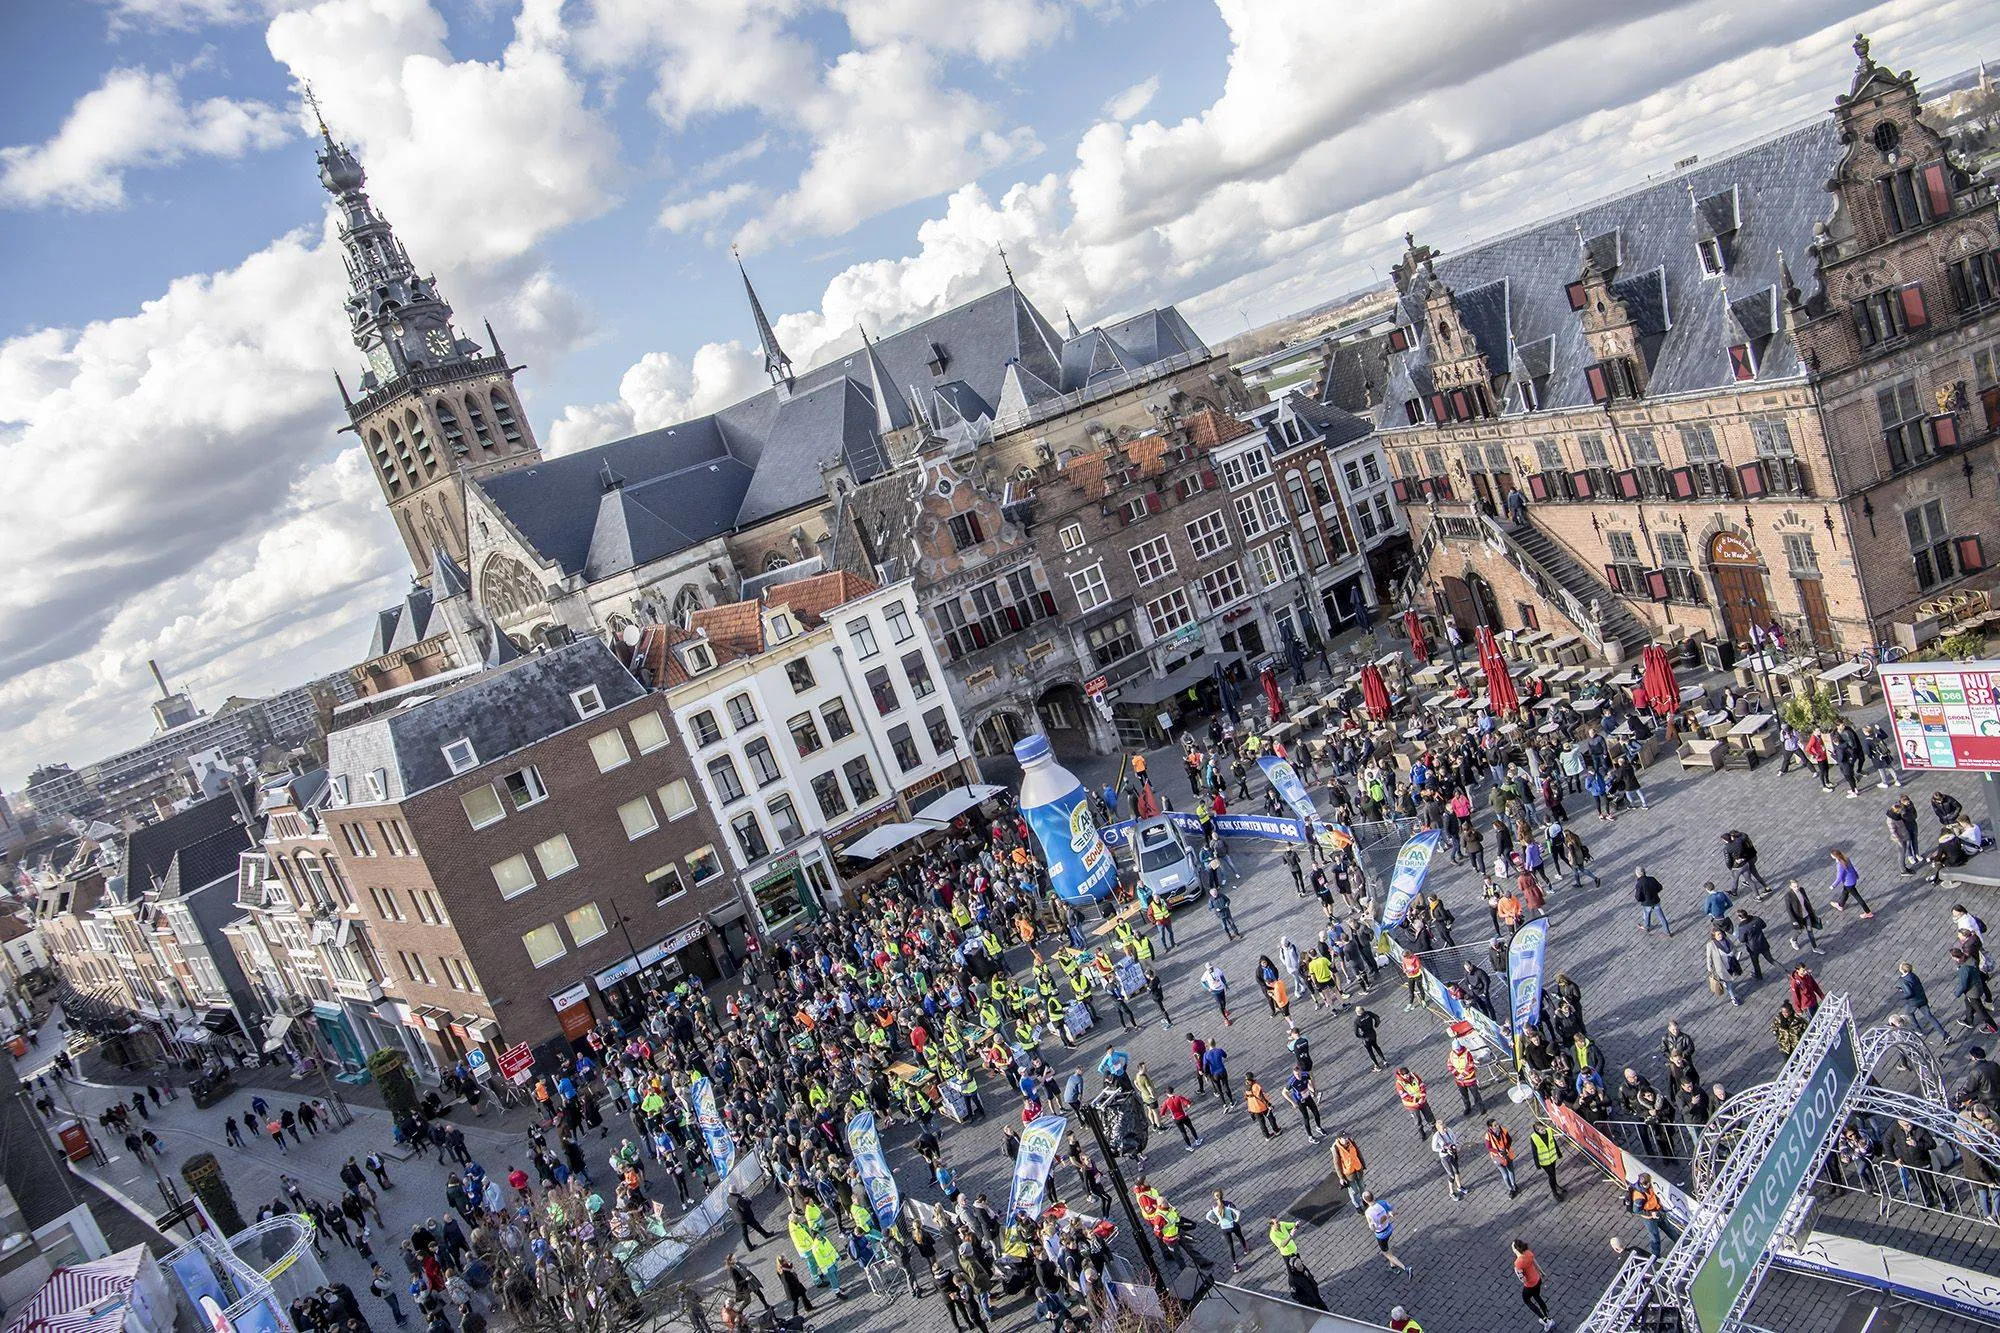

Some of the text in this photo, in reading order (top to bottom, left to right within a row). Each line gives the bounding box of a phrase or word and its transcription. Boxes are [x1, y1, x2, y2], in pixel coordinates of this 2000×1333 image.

[1964, 673, 1988, 689] NU
[1942, 692, 1961, 700] D66
[1409, 850, 1425, 861] AA
[1033, 1136, 1049, 1147] AA
[1718, 1067, 1839, 1287] Stevensloop
